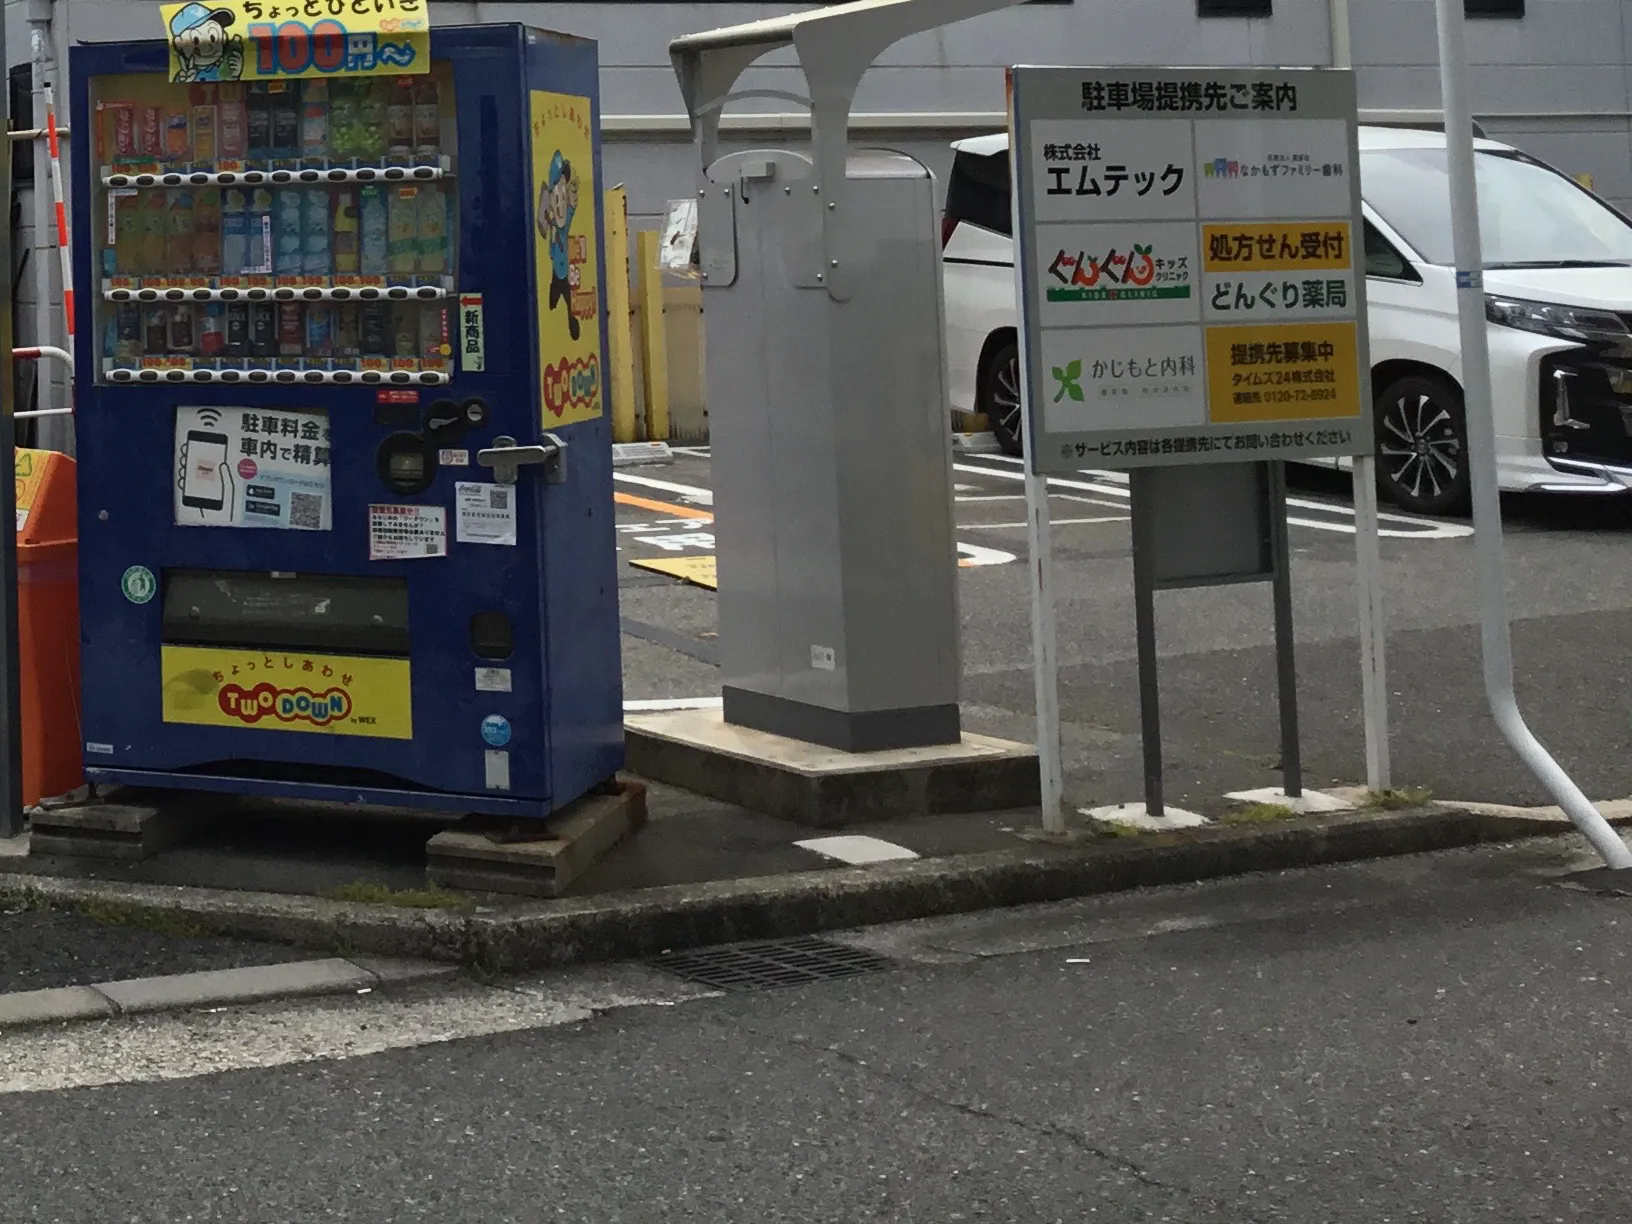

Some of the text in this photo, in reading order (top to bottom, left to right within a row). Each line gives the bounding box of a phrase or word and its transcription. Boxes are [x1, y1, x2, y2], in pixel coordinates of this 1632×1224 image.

[1081, 81, 1298, 112] 駐車場提携先ご案内
[1044, 143, 1101, 161] 株式会社
[1047, 164, 1184, 196] エムテック
[1240, 163, 1344, 177] なかもずファミリー歯科
[1209, 231, 1345, 262] 処方せん受付
[1048, 246, 1155, 287] ぐんぐん
[1155, 271, 1189, 282] クリニック
[1156, 257, 1188, 270] キッズ
[1211, 279, 1348, 312] どんぐり薬局
[464, 309, 481, 354] 新商品
[1092, 354, 1196, 379] かじもと内科
[1231, 340, 1335, 366] 提携先募集中
[1232, 368, 1336, 387] タイムズ24株式会社
[240, 437, 331, 467] 車内で精算
[211, 656, 353, 687] ちょっとしあわせ
[225, 690, 344, 720] TWO DOWN
